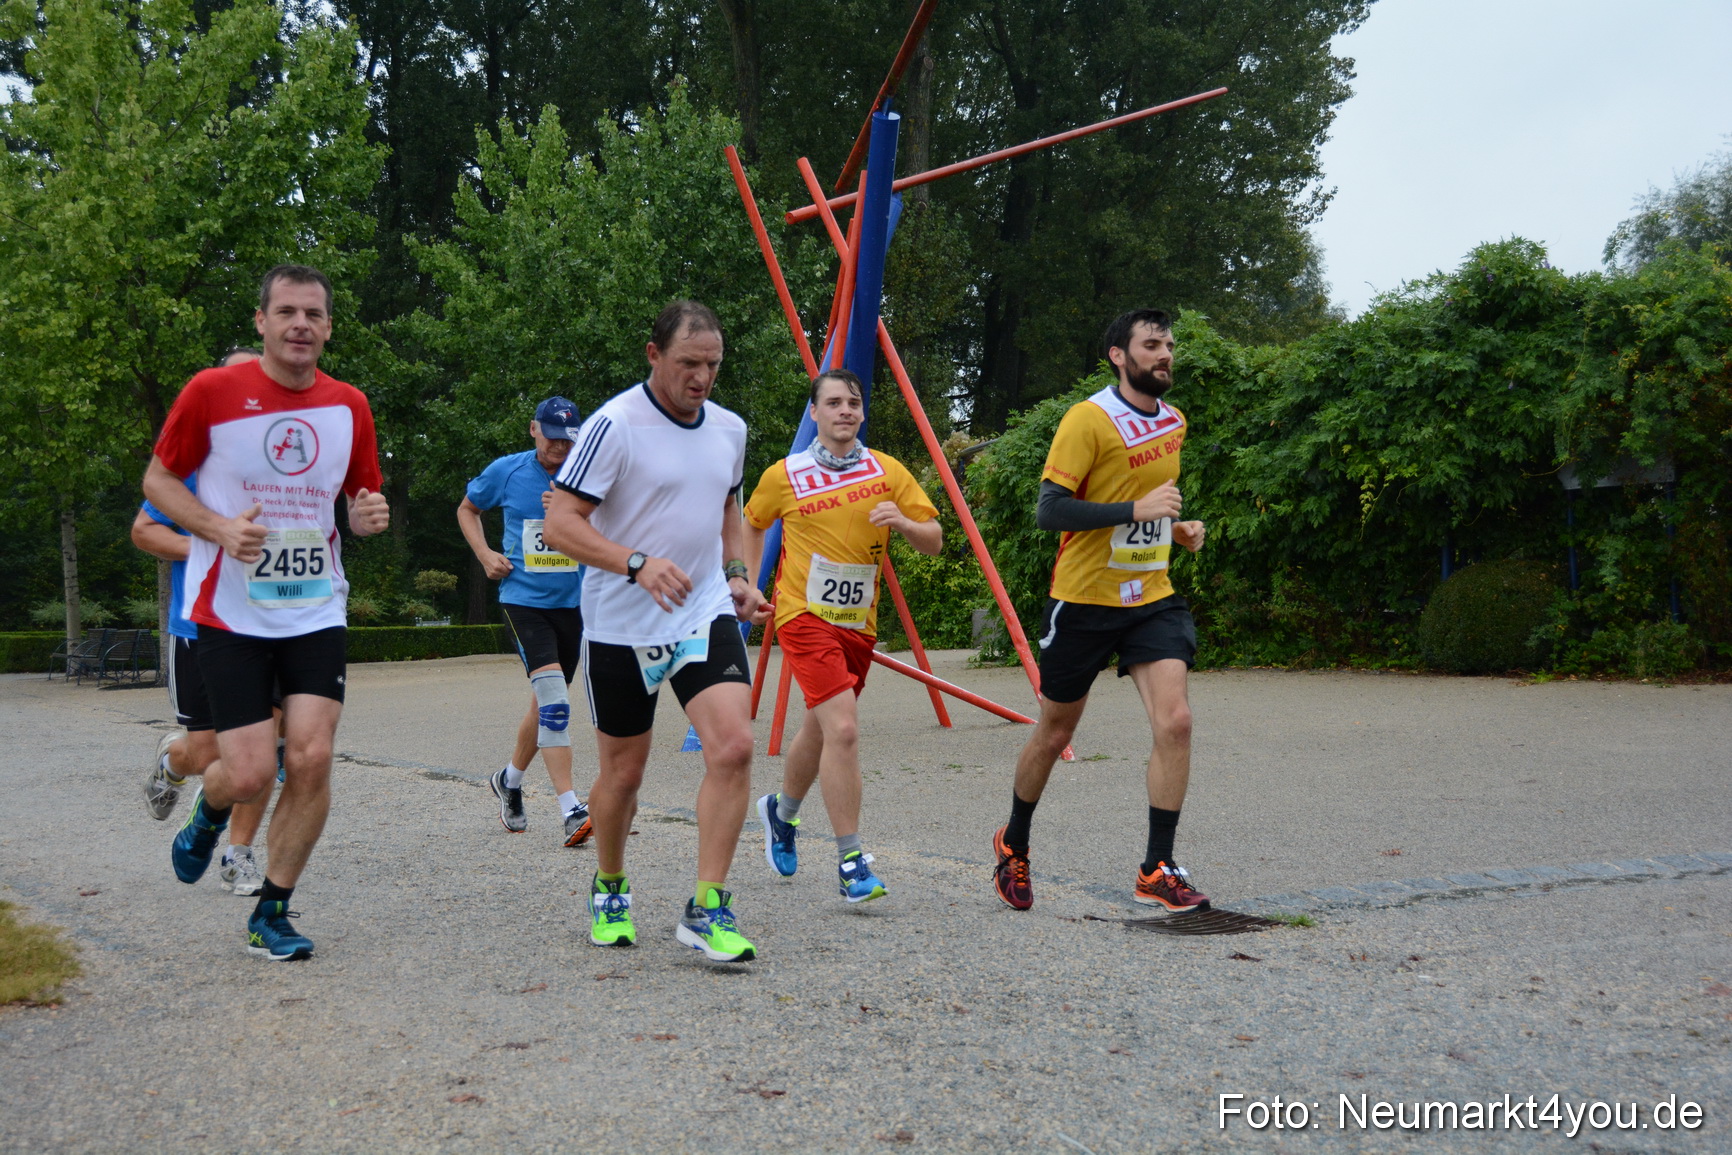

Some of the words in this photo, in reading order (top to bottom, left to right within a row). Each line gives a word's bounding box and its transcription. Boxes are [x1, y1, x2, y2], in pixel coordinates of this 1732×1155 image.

[1128, 445, 1163, 469] MAX
[1164, 434, 1183, 456] BÖG
[243, 480, 282, 494] LAUFEN
[305, 485, 331, 499] HERZ
[798, 495, 843, 517] MAX
[846, 481, 892, 504] BÖGL
[1126, 518, 1162, 545] 294
[254, 547, 324, 577] 2455
[534, 556, 570, 567] Wolfgang
[1131, 549, 1157, 562] Roland
[277, 584, 303, 597] Willi
[821, 578, 865, 605] 295
[820, 608, 858, 621] Johannes
